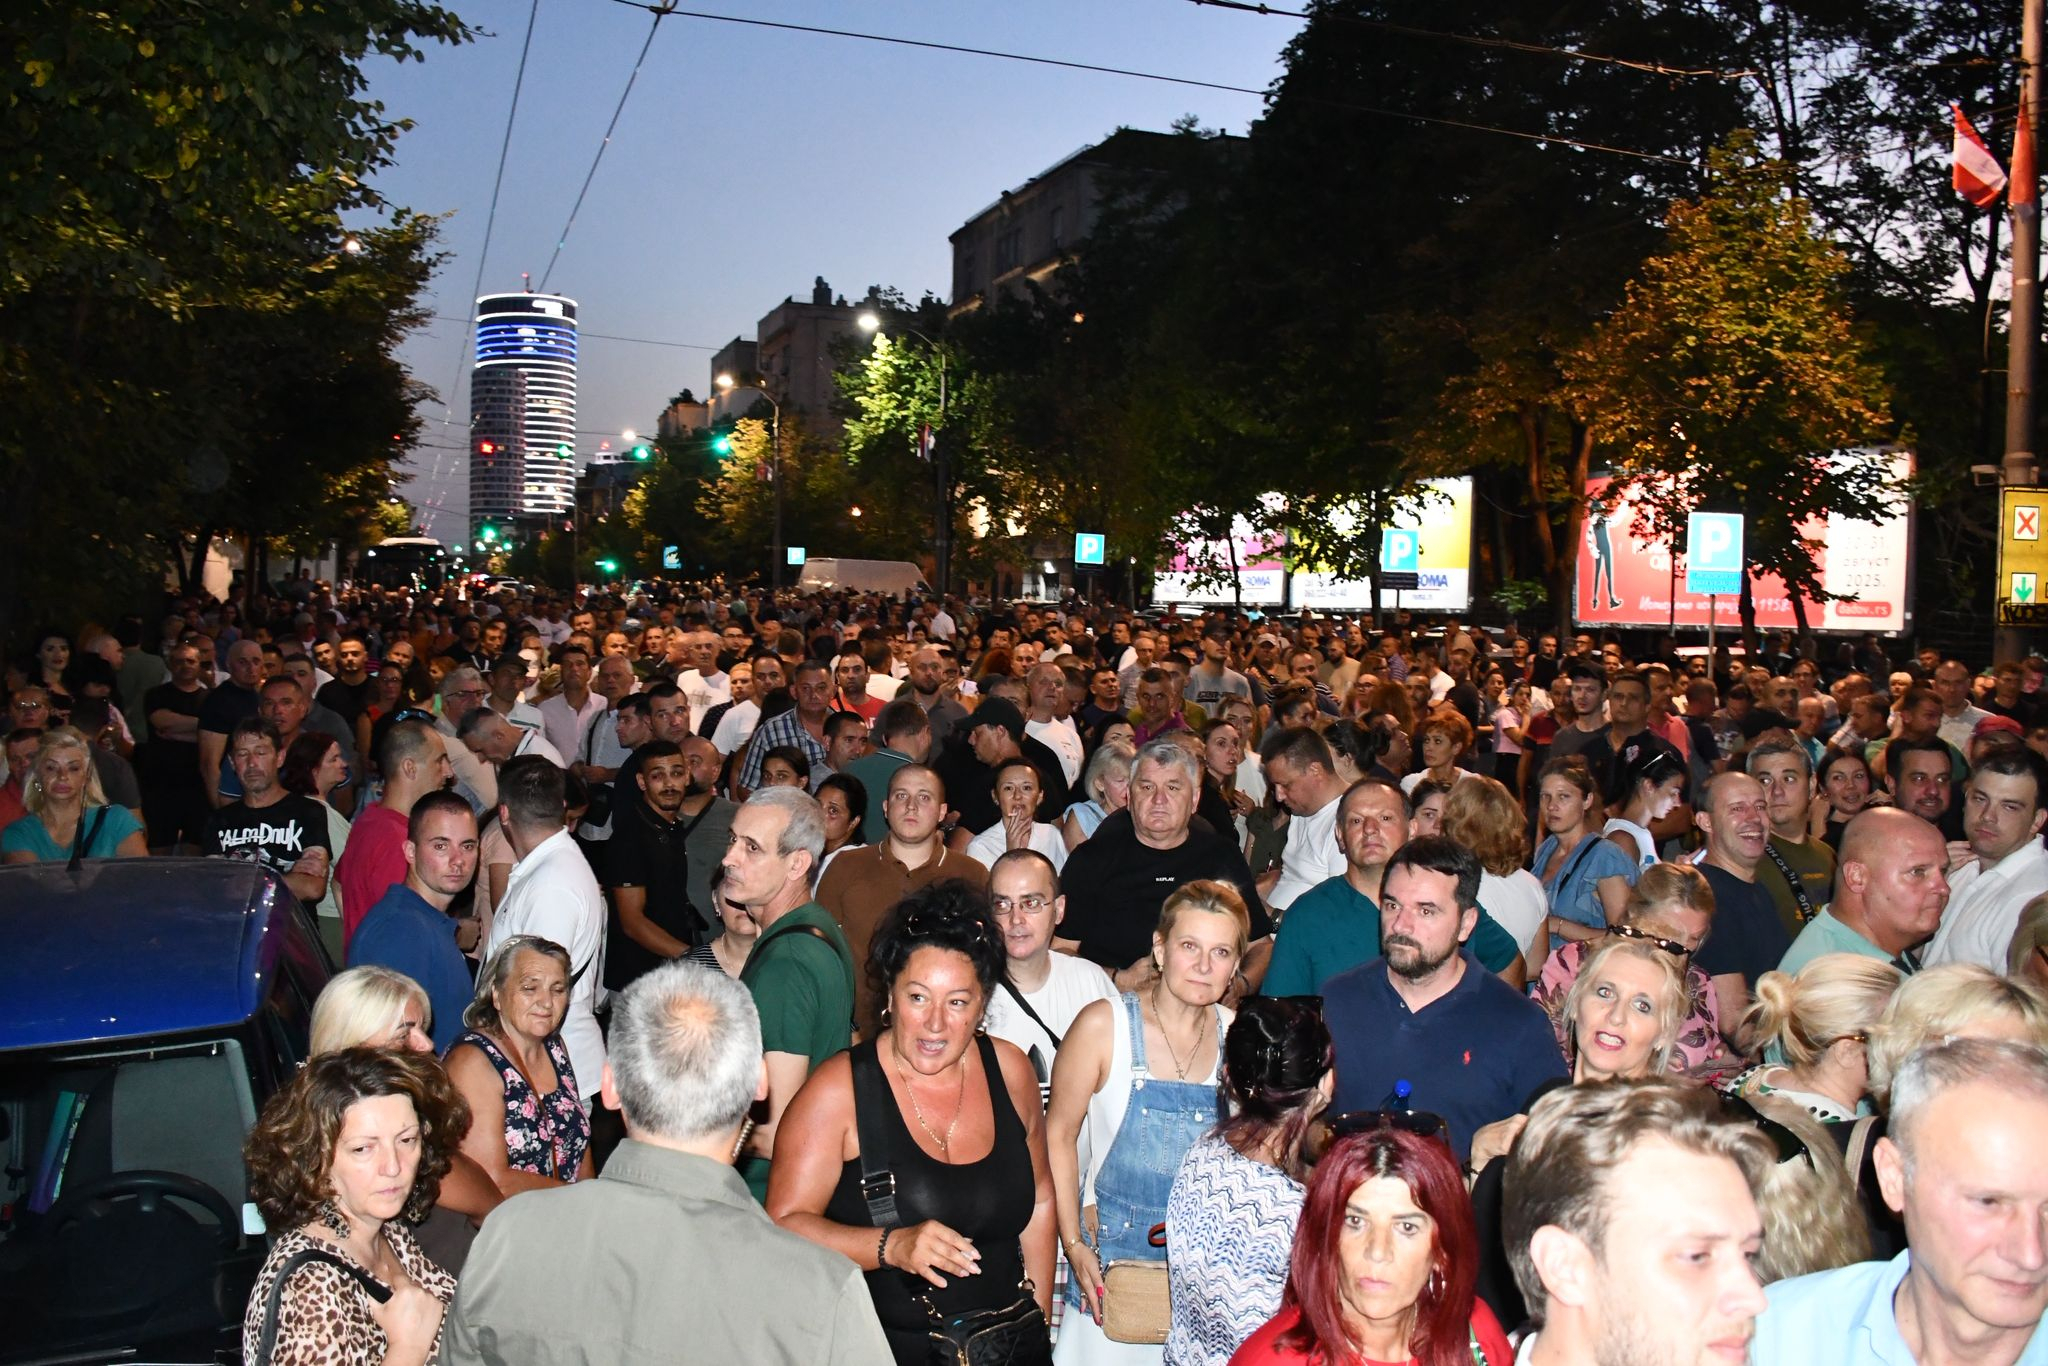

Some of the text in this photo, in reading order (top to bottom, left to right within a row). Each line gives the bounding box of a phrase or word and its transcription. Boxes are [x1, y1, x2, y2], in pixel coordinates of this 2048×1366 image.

[1081, 537, 1098, 560] P
[1389, 533, 1412, 567] P
[1699, 520, 1731, 563] P
